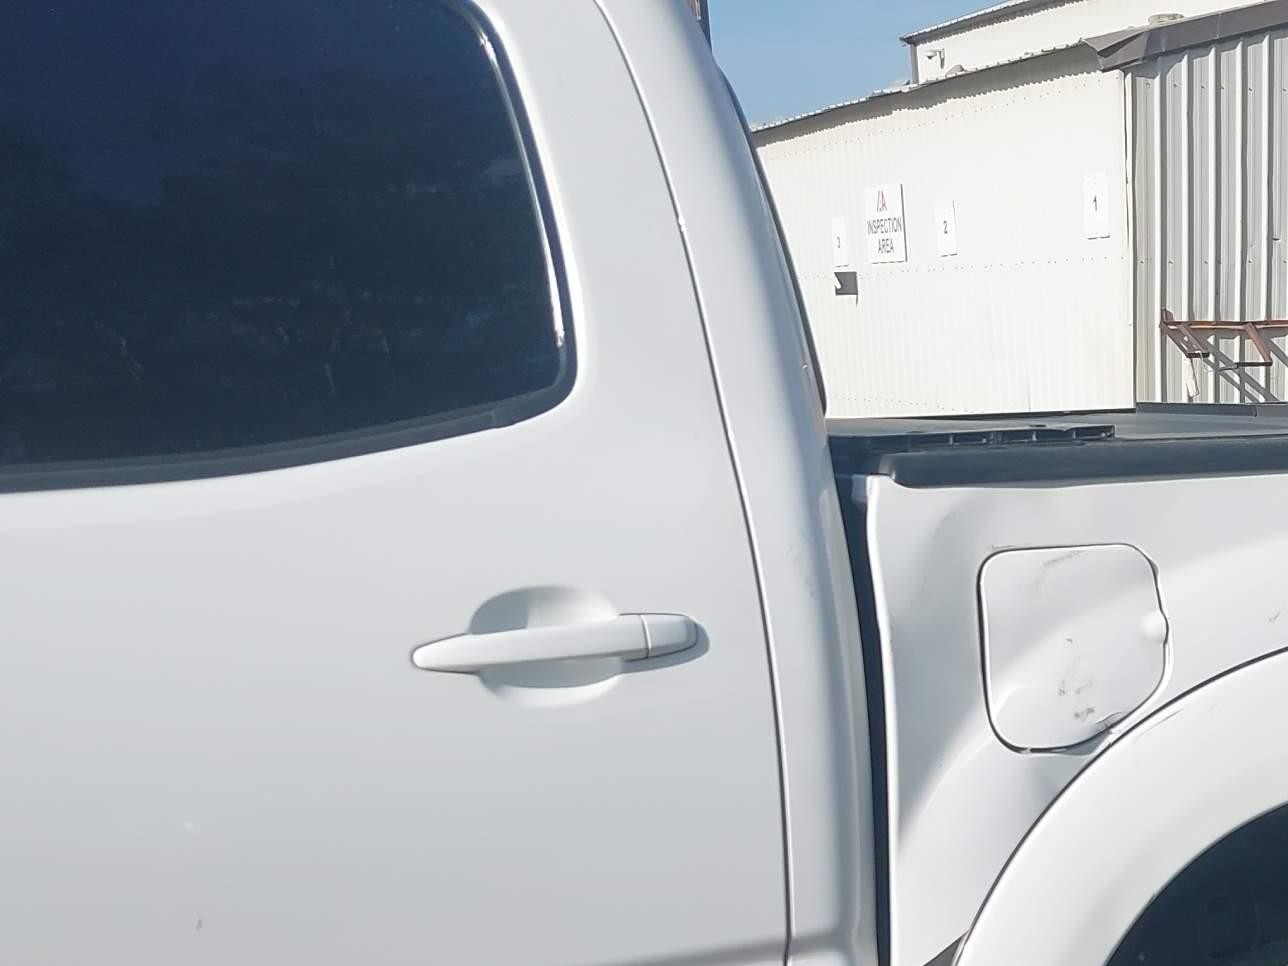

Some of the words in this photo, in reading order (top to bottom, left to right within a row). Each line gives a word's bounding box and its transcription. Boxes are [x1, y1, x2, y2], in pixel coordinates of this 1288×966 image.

[867, 217, 902, 234] INSPECTION
[943, 220, 948, 234] 2
[878, 238, 895, 253] AREA
